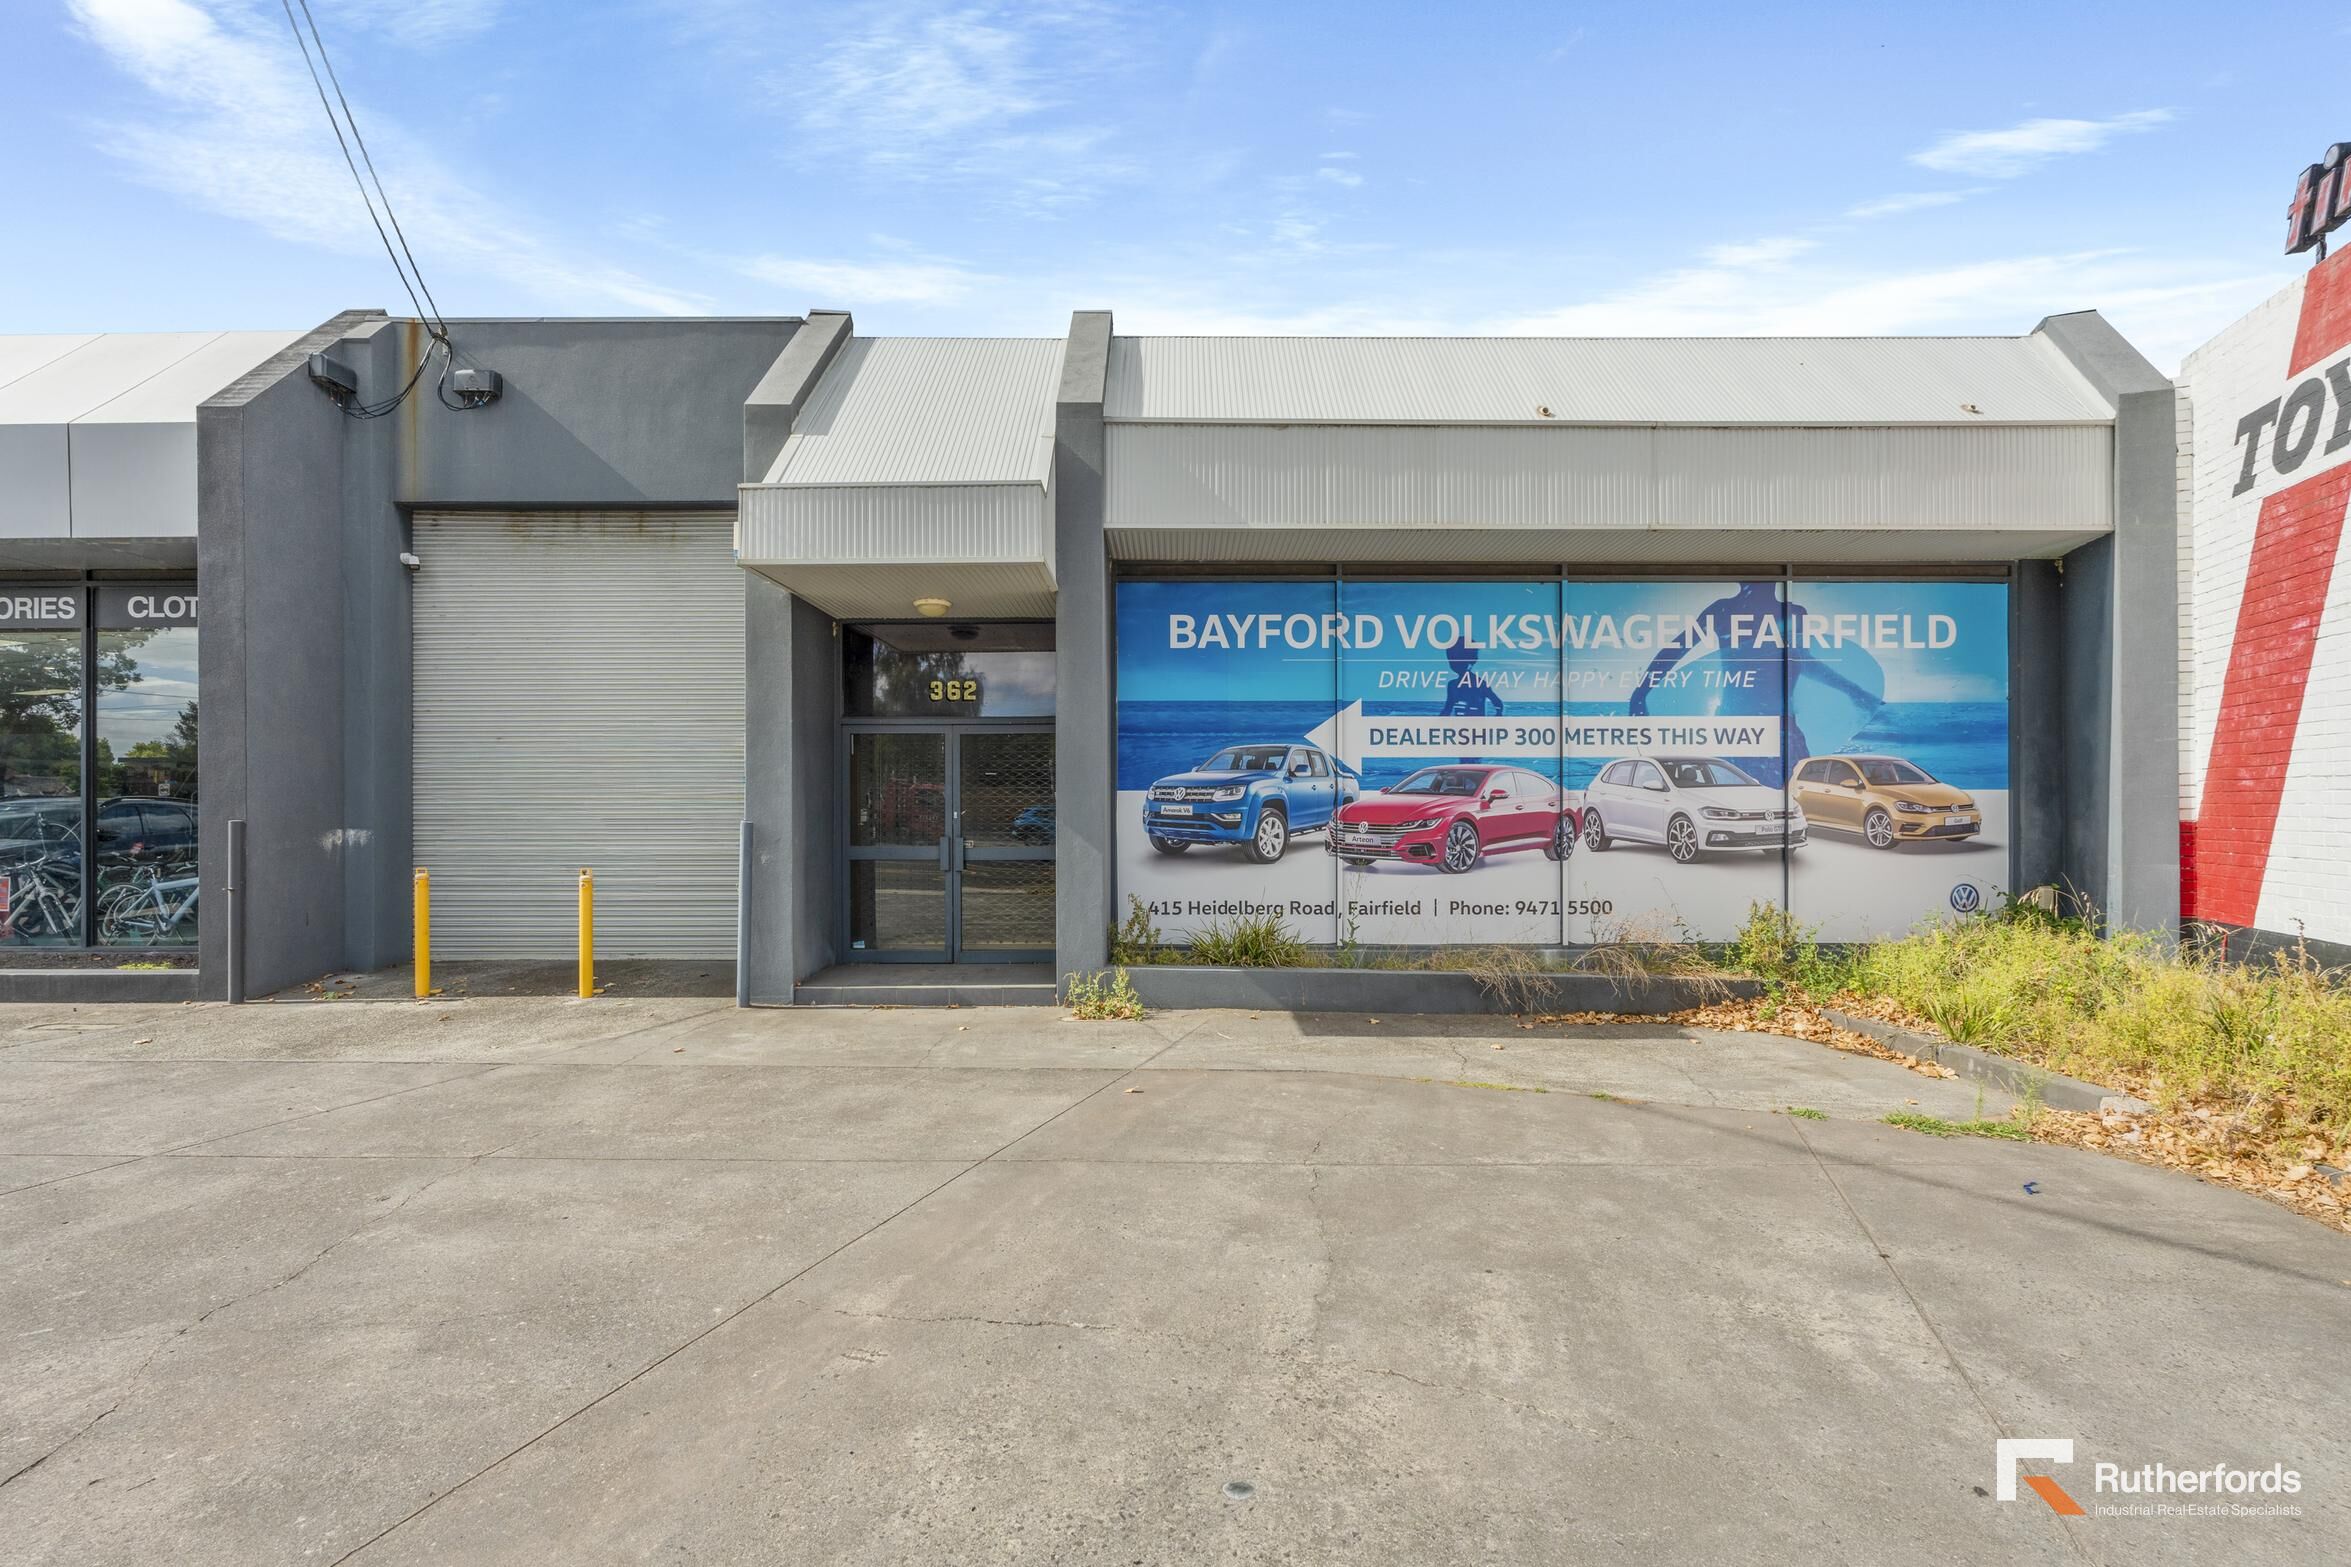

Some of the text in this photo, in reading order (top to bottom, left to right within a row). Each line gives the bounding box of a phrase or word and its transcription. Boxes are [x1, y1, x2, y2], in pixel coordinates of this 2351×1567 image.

[0, 596, 76, 620] ORIES
[127, 595, 199, 618] CLOT
[1169, 613, 1958, 650] BAYFORD VOLKSWAGEN FAIRFIELD
[1378, 670, 1757, 690] DRIVE AWAY HAPPY EVERY TIME
[929, 680, 978, 702] 362
[1369, 727, 1766, 747] DEALERSHIP 300 METRES THIS WAY
[1351, 835, 1374, 843] Arteon
[1149, 900, 1183, 916] 415
[1188, 899, 1284, 919] Heidelberg
[1348, 899, 1422, 916] Fairfield
[1449, 900, 1511, 916] Phone:
[1515, 900, 1560, 916] 9471
[1567, 900, 1613, 916] 5500
